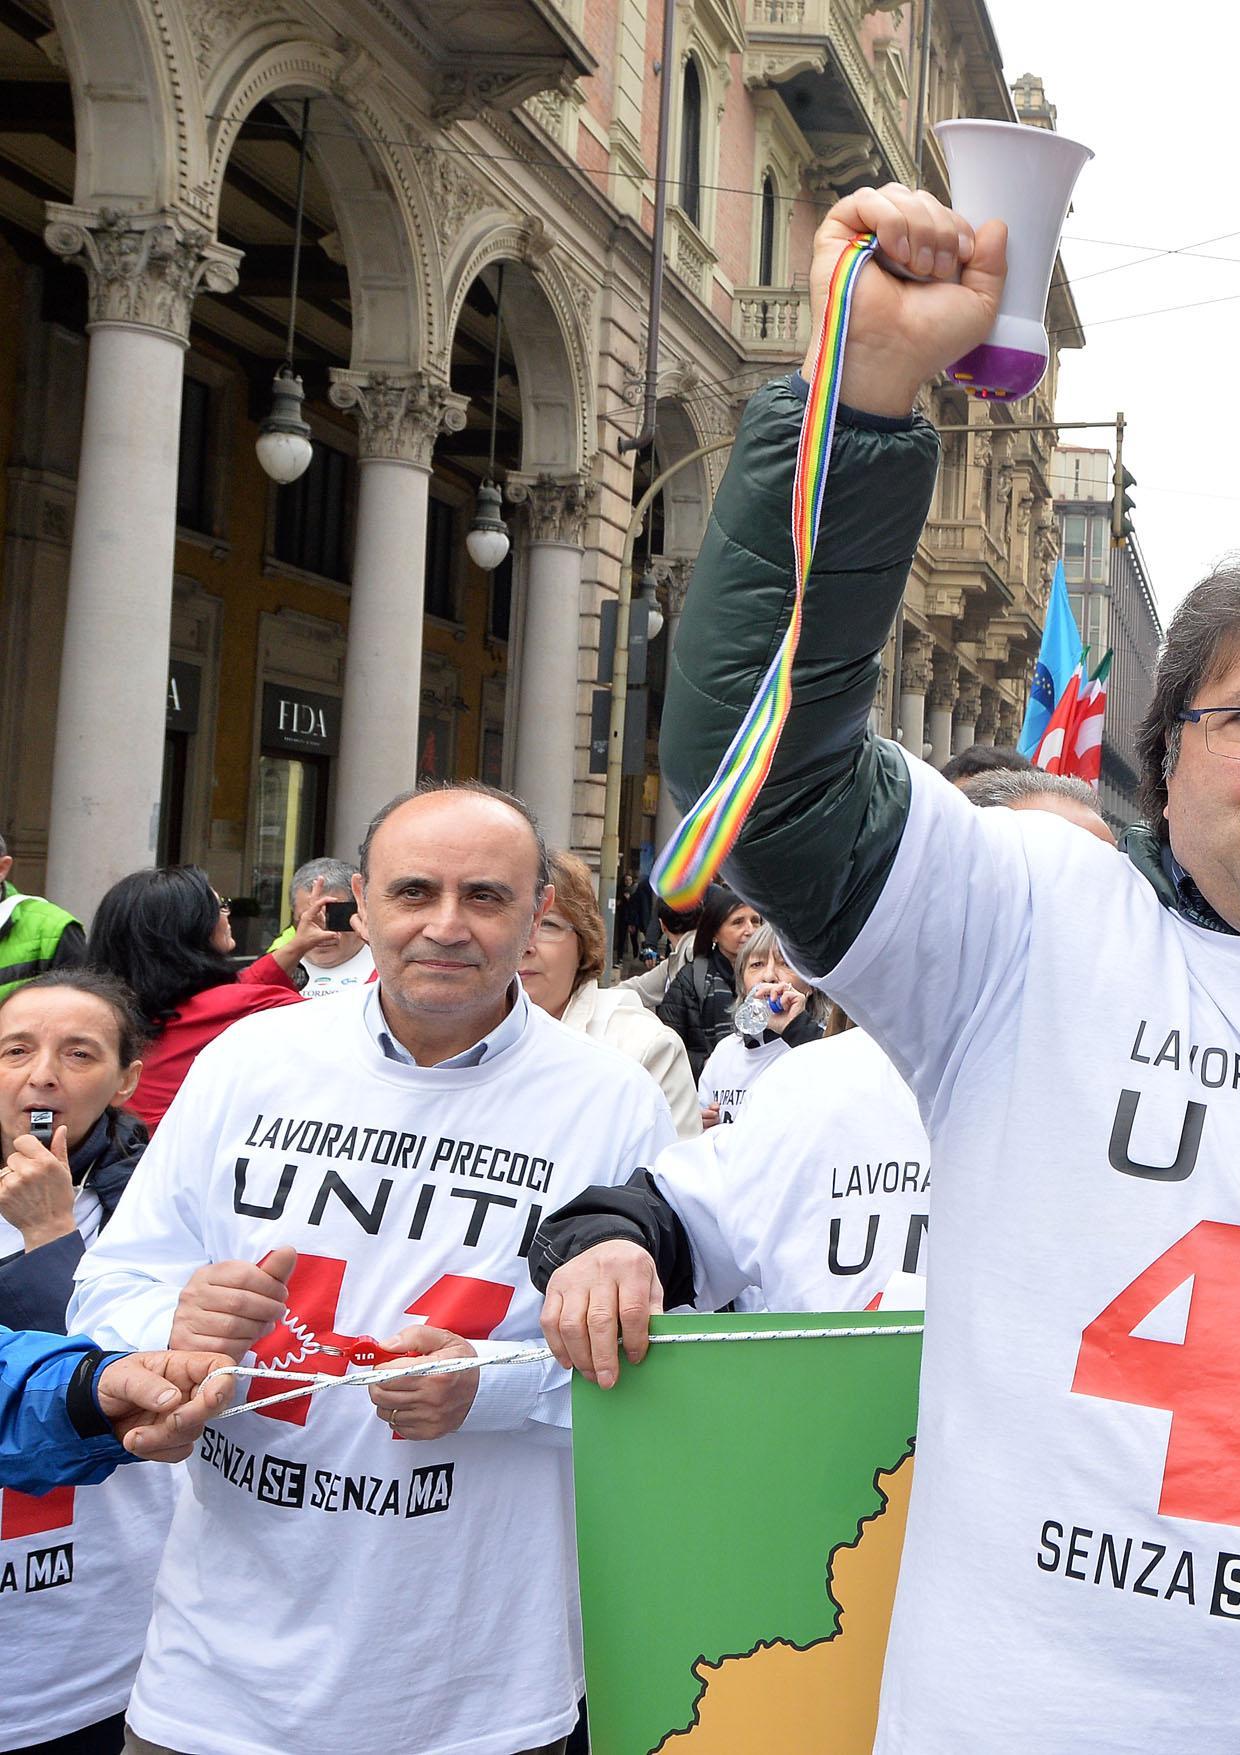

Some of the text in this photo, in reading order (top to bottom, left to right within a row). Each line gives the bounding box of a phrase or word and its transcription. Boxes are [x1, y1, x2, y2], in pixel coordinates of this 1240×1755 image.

[277, 699, 328, 738] FIDA
[244, 1114, 554, 1194] LAVORATORI PRECOCI
[234, 1158, 542, 1258] UNITI
[200, 1426, 450, 1516] SENZA SE SENZA MA
[28, 1549, 71, 1589] MA
[1037, 1519, 1196, 1606] SENZA
